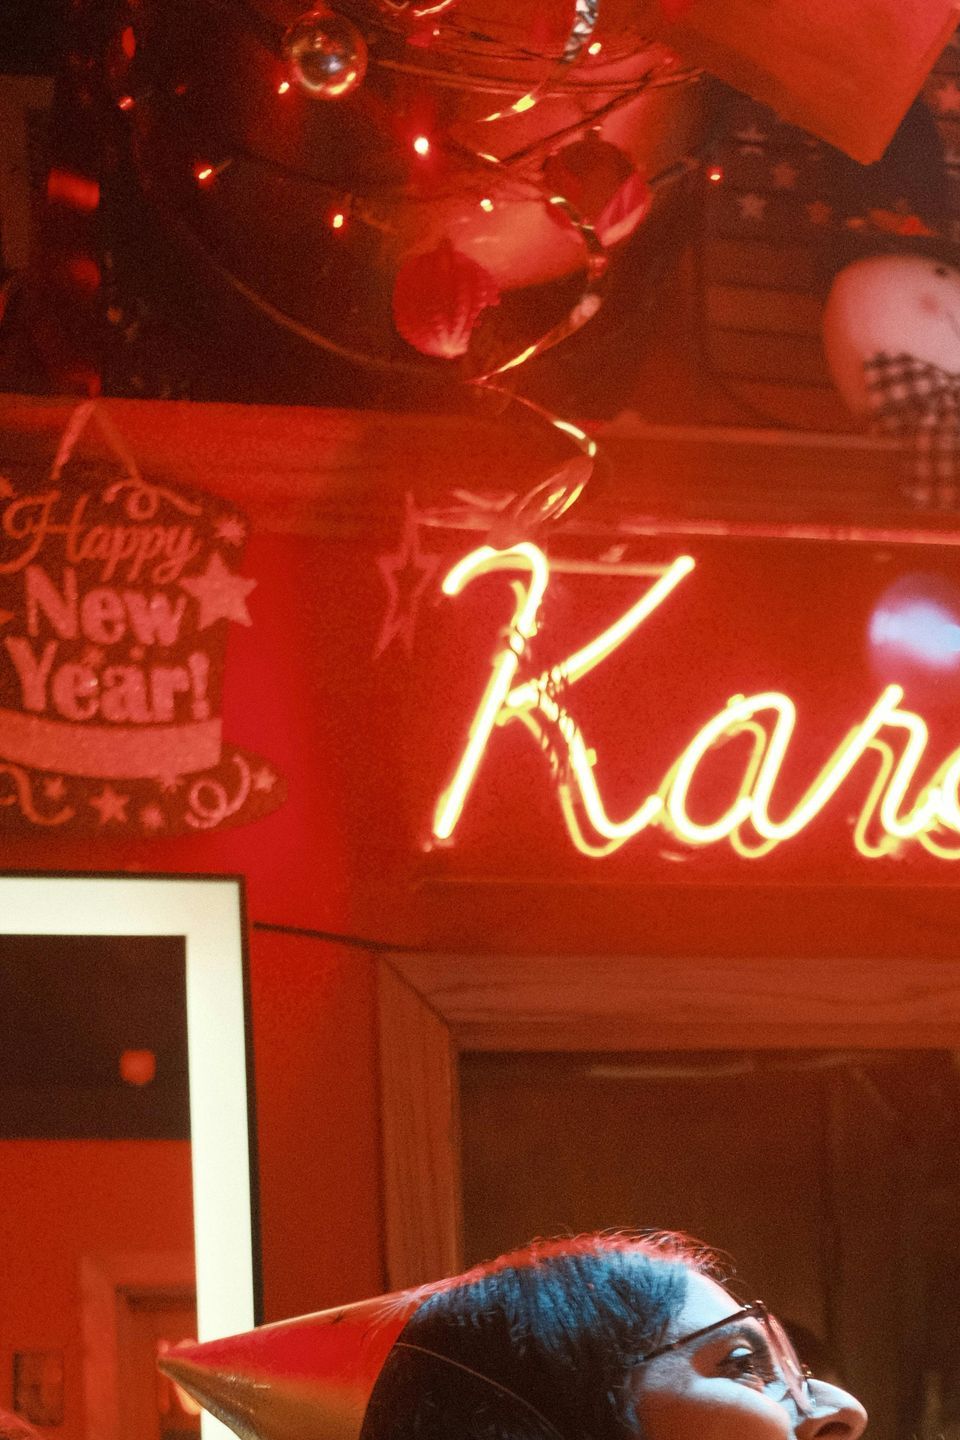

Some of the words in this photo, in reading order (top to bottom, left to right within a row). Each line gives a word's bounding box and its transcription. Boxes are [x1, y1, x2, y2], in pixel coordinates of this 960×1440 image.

[0, 489, 202, 585] Happy
[24, 564, 188, 647] New
[4, 637, 211, 723] Year!
